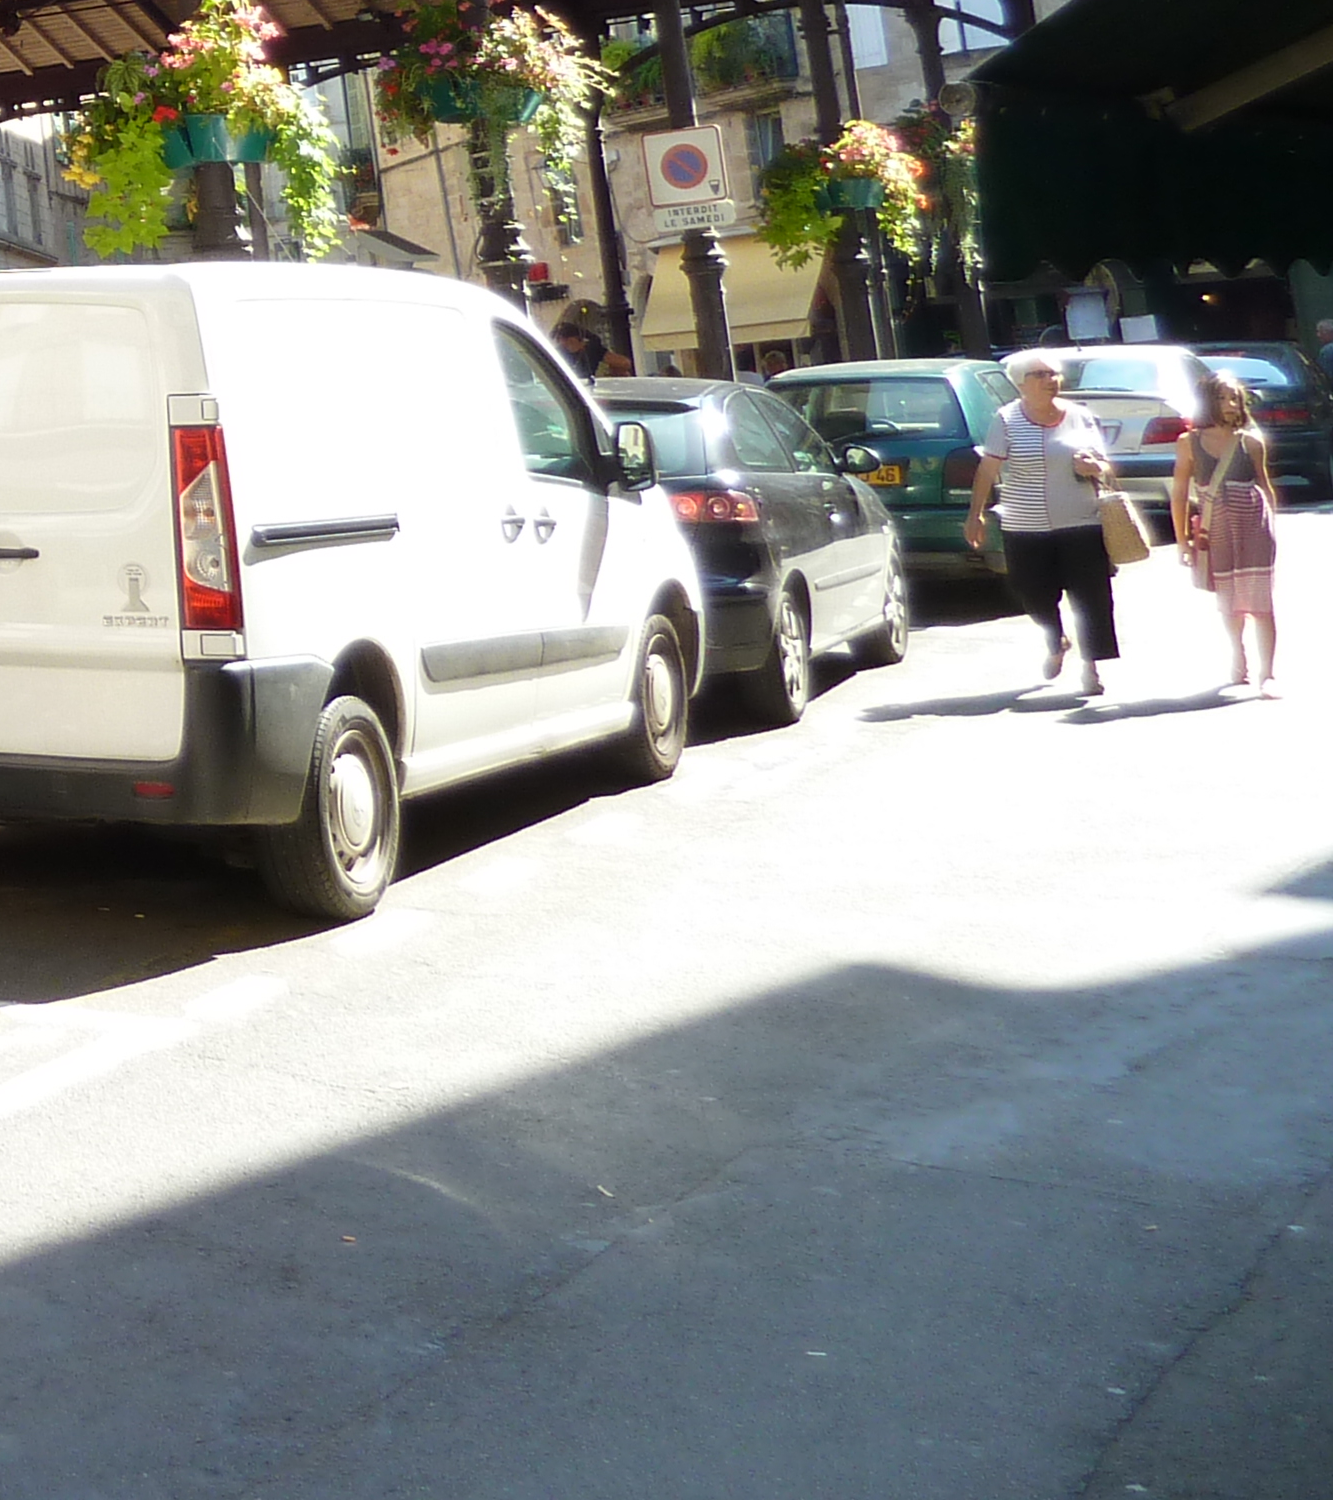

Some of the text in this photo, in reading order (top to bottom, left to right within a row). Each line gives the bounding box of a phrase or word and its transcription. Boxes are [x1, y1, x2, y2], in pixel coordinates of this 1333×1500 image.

[667, 204, 719, 217] INTERDIT
[664, 213, 725, 228] LE SAMEDI
[877, 467, 896, 482] 46
